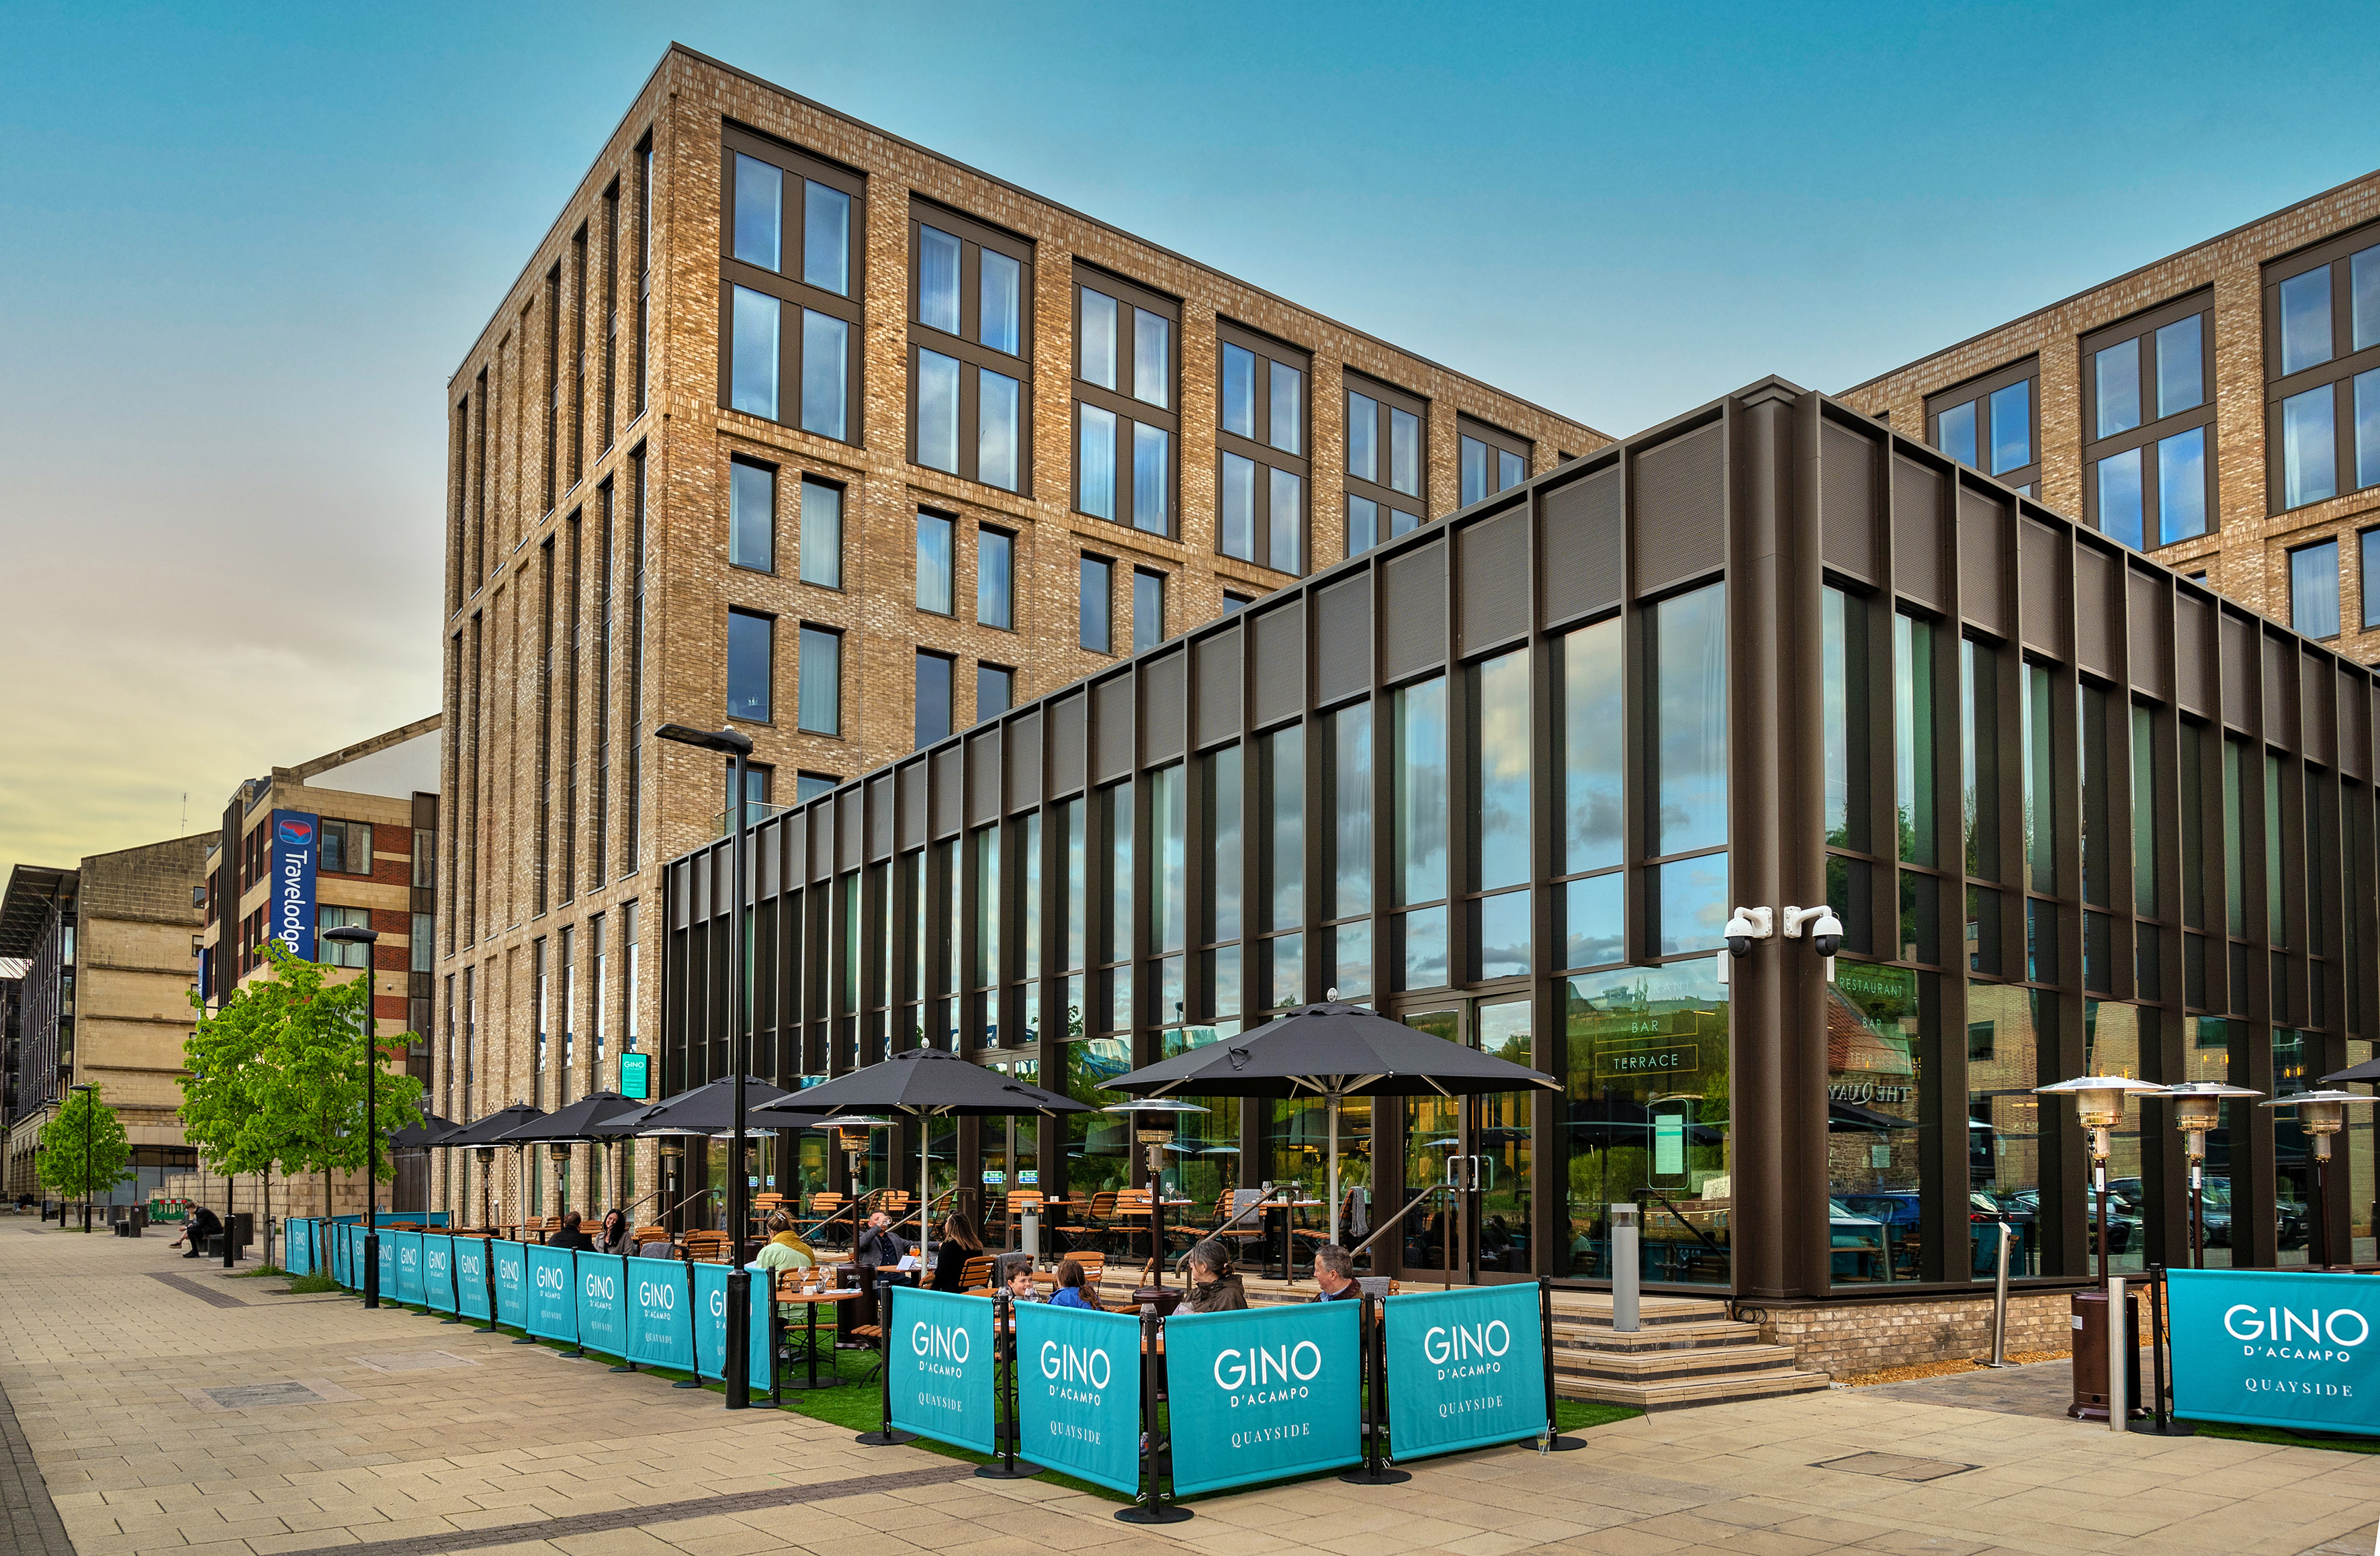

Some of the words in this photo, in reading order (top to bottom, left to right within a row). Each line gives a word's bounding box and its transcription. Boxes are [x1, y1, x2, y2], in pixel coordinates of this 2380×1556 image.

[277, 850, 308, 954] Travelodge
[1600, 979, 1690, 1000] RESTRANT
[1839, 977, 1903, 997] RESTAURANT
[1632, 1020, 1659, 1034] BAR
[1863, 1017, 1881, 1030] BAR
[1614, 1054, 1678, 1070] TERRACE
[355, 1240, 365, 1255] GIN
[401, 1247, 416, 1265] GINO
[429, 1250, 445, 1270] GINO
[461, 1254, 480, 1275] GINO
[500, 1258, 519, 1281] GINO
[537, 1266, 563, 1290] GINO
[586, 1273, 614, 1300] GINO
[640, 1281, 674, 1310] GINO
[644, 1310, 671, 1321] D'ACAMPO
[2224, 1303, 2369, 1346] GINO
[645, 1332, 672, 1344] QUAYSIDE
[912, 1321, 969, 1363] GINO
[1424, 1320, 1510, 1365] GINO
[2244, 1345, 2350, 1362] D'ACAMPO
[919, 1361, 962, 1378] D'ACAMPO
[1041, 1340, 1110, 1389] GINO
[1214, 1340, 1321, 1390] GINO
[1438, 1361, 1501, 1381] D'ACAMPO
[1049, 1384, 1100, 1406] D'ACAMPO
[1231, 1386, 1309, 1408] D'ACAMPO
[2245, 1377, 2352, 1397] QUAYSIDE
[918, 1391, 962, 1412] QUAYSIDE
[1439, 1395, 1503, 1418] QUAYSIDE
[1050, 1420, 1101, 1445] QUAYSIDE
[1231, 1422, 1310, 1448] QUAYSIDE
